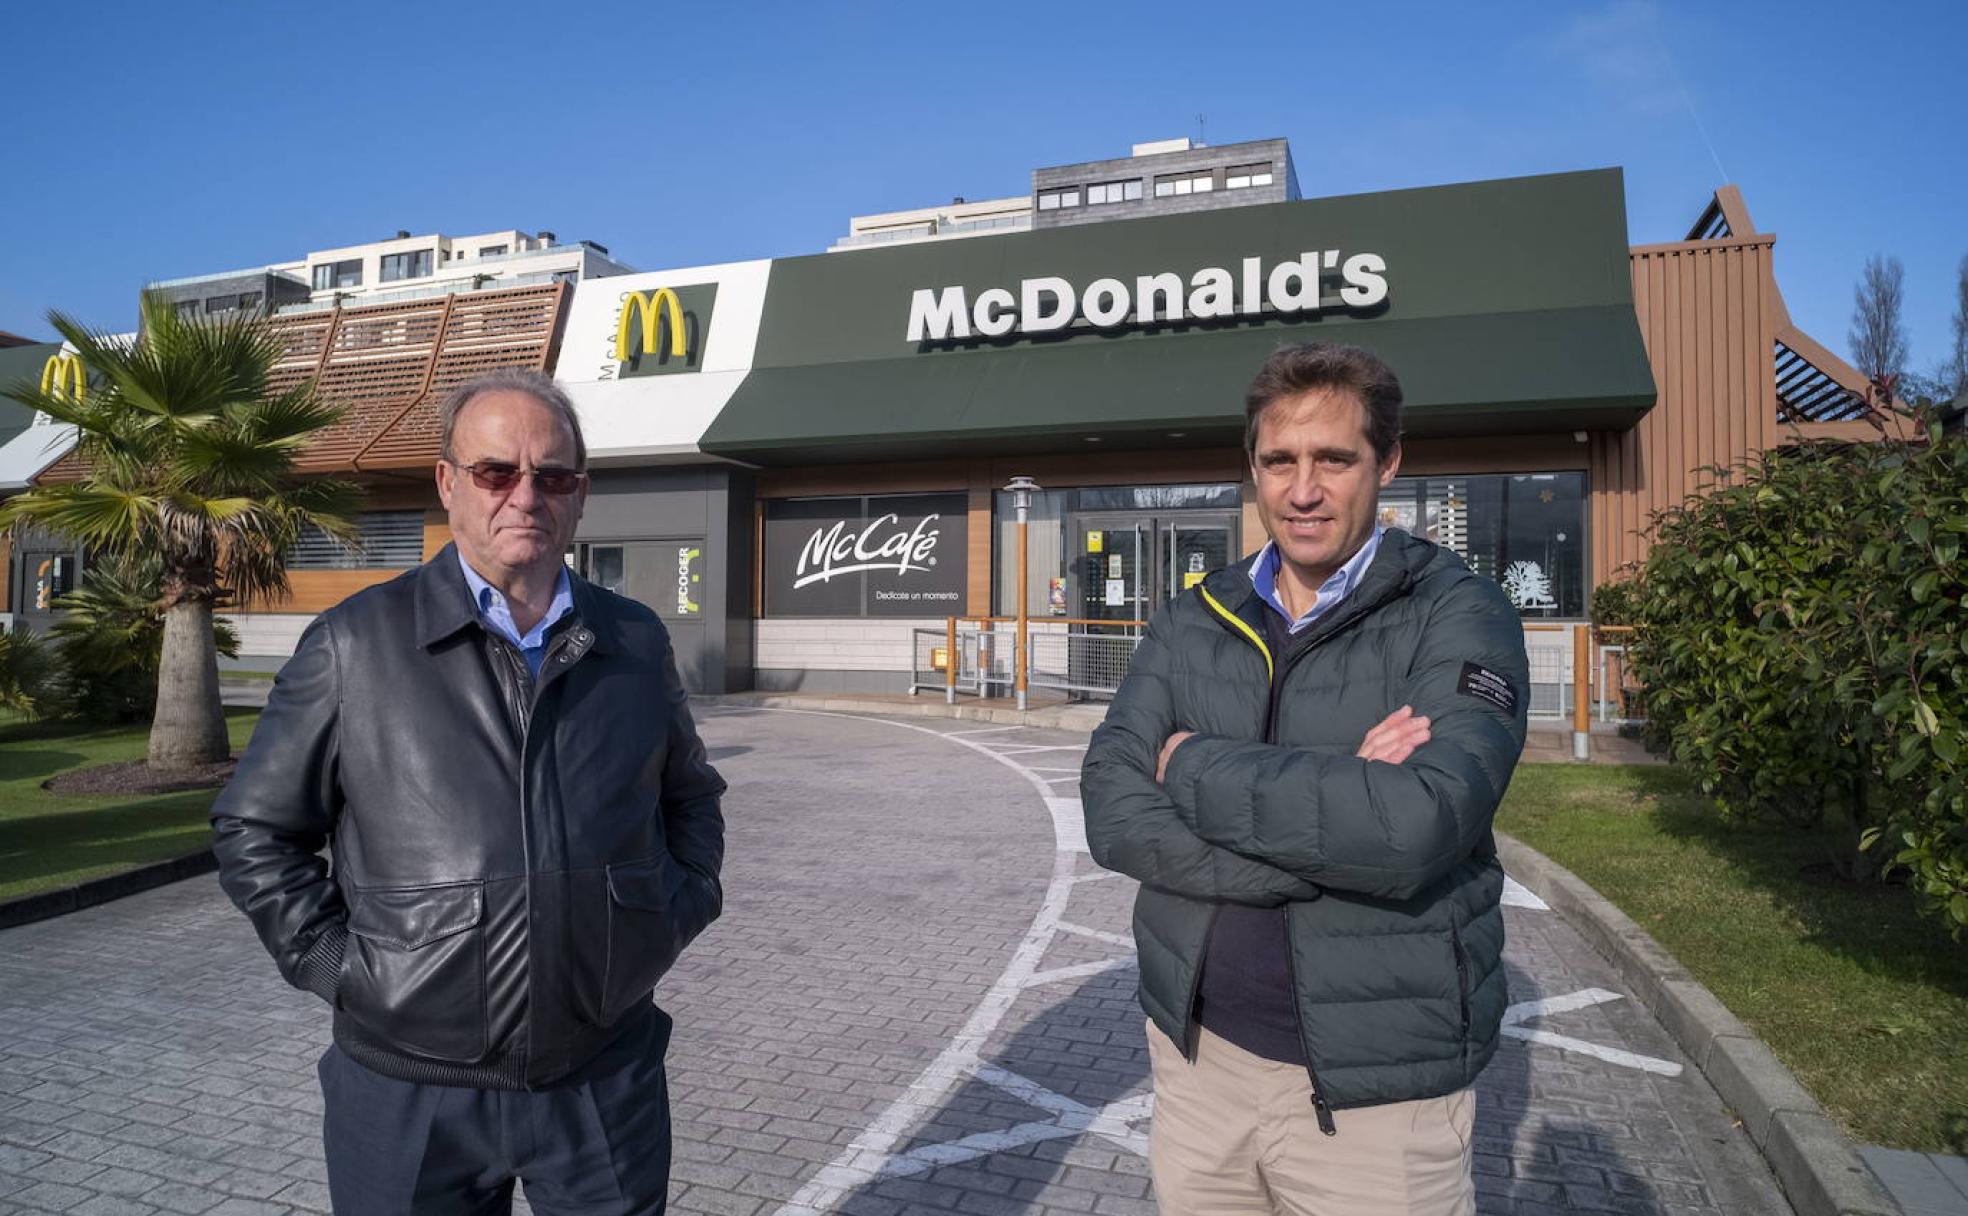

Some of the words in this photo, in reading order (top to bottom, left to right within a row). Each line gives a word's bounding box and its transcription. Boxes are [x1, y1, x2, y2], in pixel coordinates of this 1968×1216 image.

[906, 249, 1389, 342] McDonald's
[678, 547, 689, 614] RECOGER
[911, 592, 920, 600] un
[922, 591, 959, 600] momento
